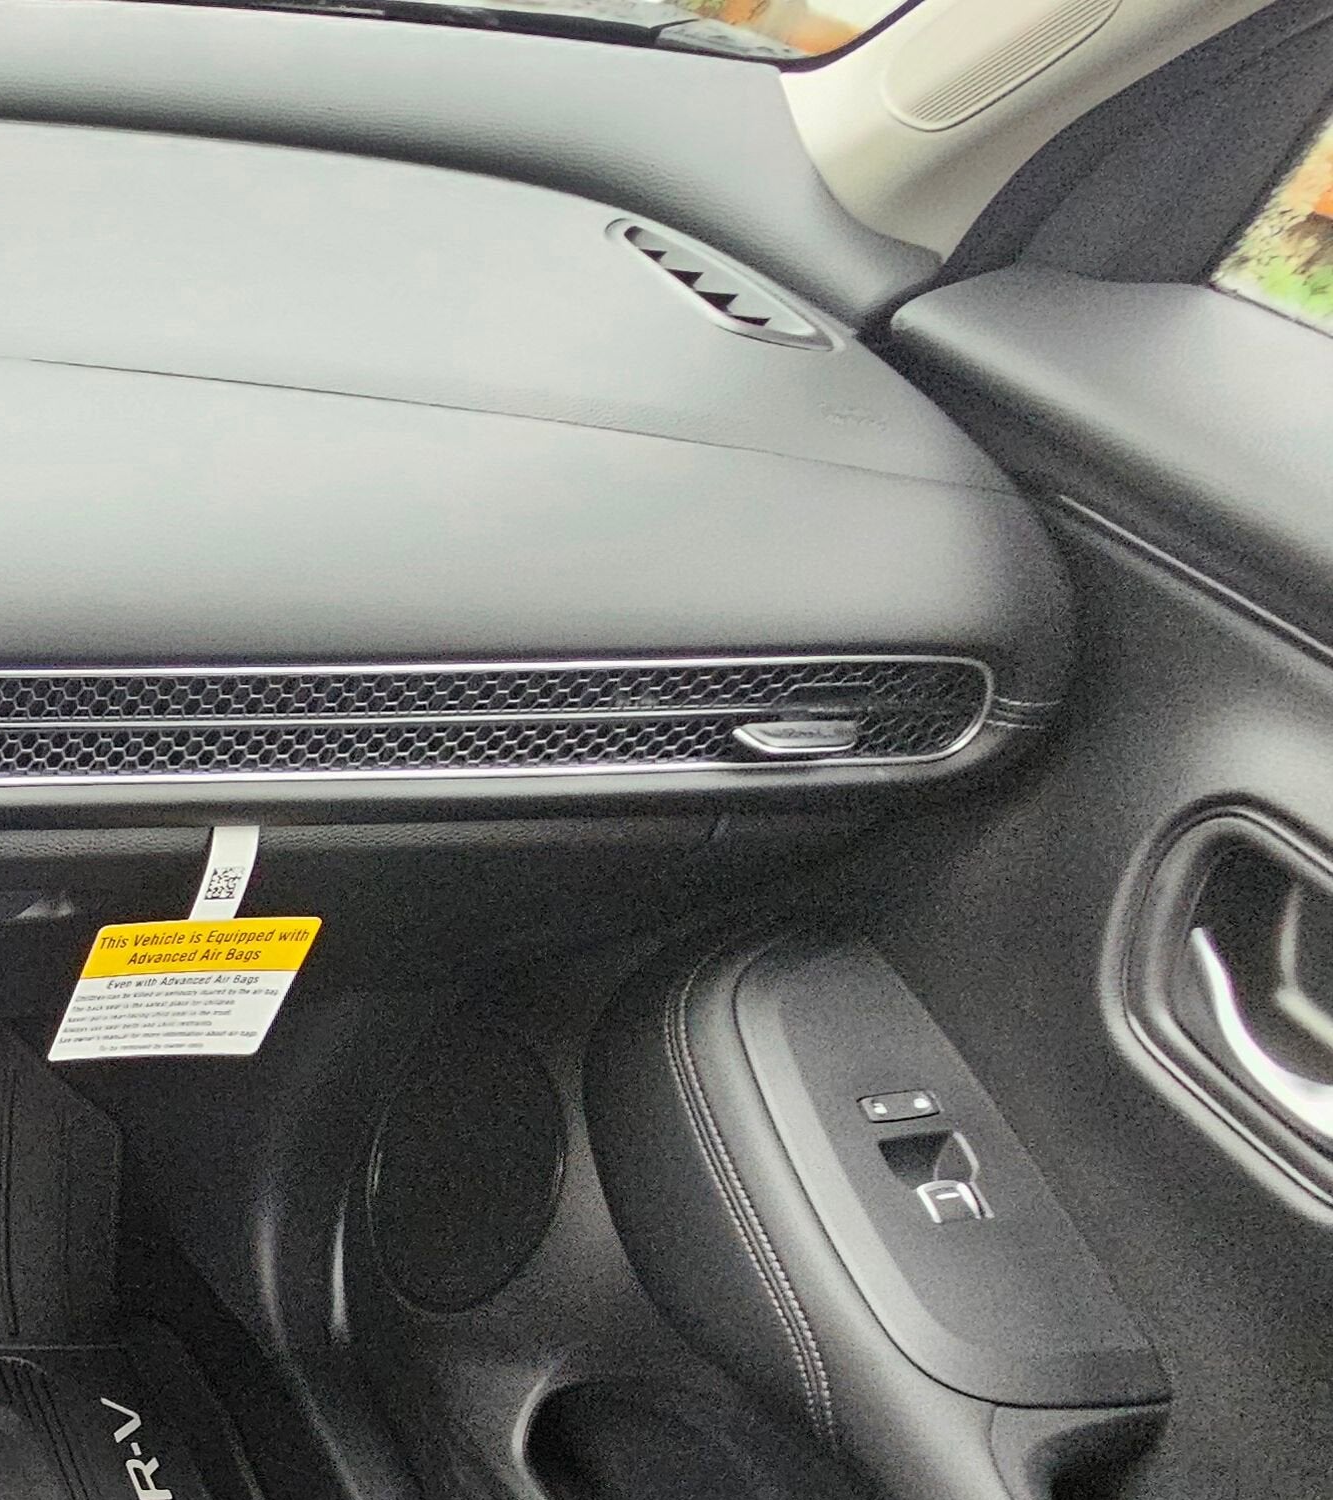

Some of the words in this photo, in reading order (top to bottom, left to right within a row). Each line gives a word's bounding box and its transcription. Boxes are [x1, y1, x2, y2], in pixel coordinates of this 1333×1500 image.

[100, 936, 129, 950] This
[133, 932, 185, 947] Vehicle
[190, 930, 203, 943] is
[206, 928, 275, 946] Equipped
[278, 928, 311, 942] with
[127, 949, 198, 966] Advanced
[200, 949, 222, 962] Air
[225, 947, 262, 963] Bags
[106, 980, 133, 990] Even
[135, 978, 158, 988] with
[159, 975, 212, 987] Advanced
[214, 975, 231, 985] Air
[233, 974, 260, 985] Bags
